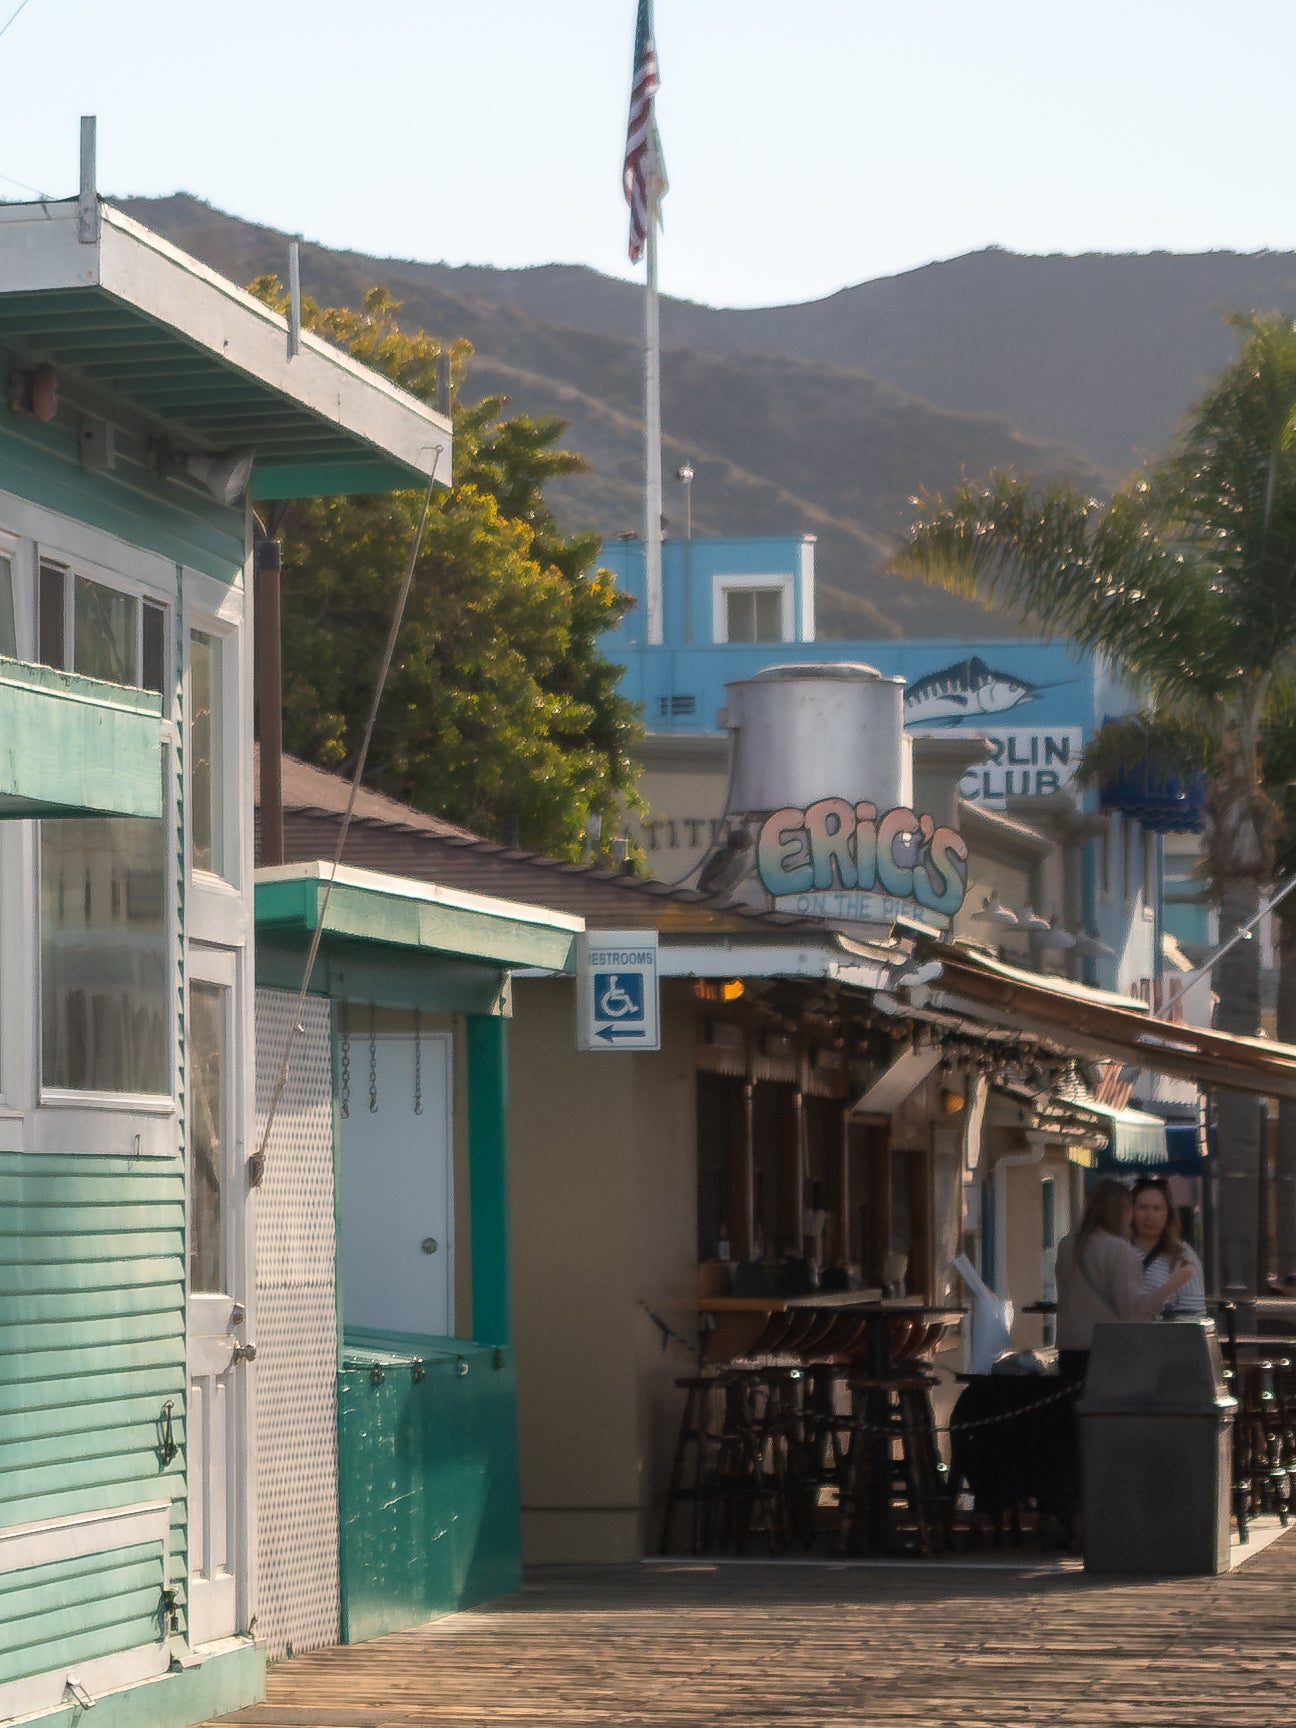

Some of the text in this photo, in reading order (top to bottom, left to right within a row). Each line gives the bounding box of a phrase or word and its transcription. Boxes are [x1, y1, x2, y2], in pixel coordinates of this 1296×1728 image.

[988, 735, 1071, 767] RLIN
[959, 769, 1061, 800] CLUB
[796, 892, 926, 922] ON THE PIER
[589, 951, 654, 966] ESTROOMS
